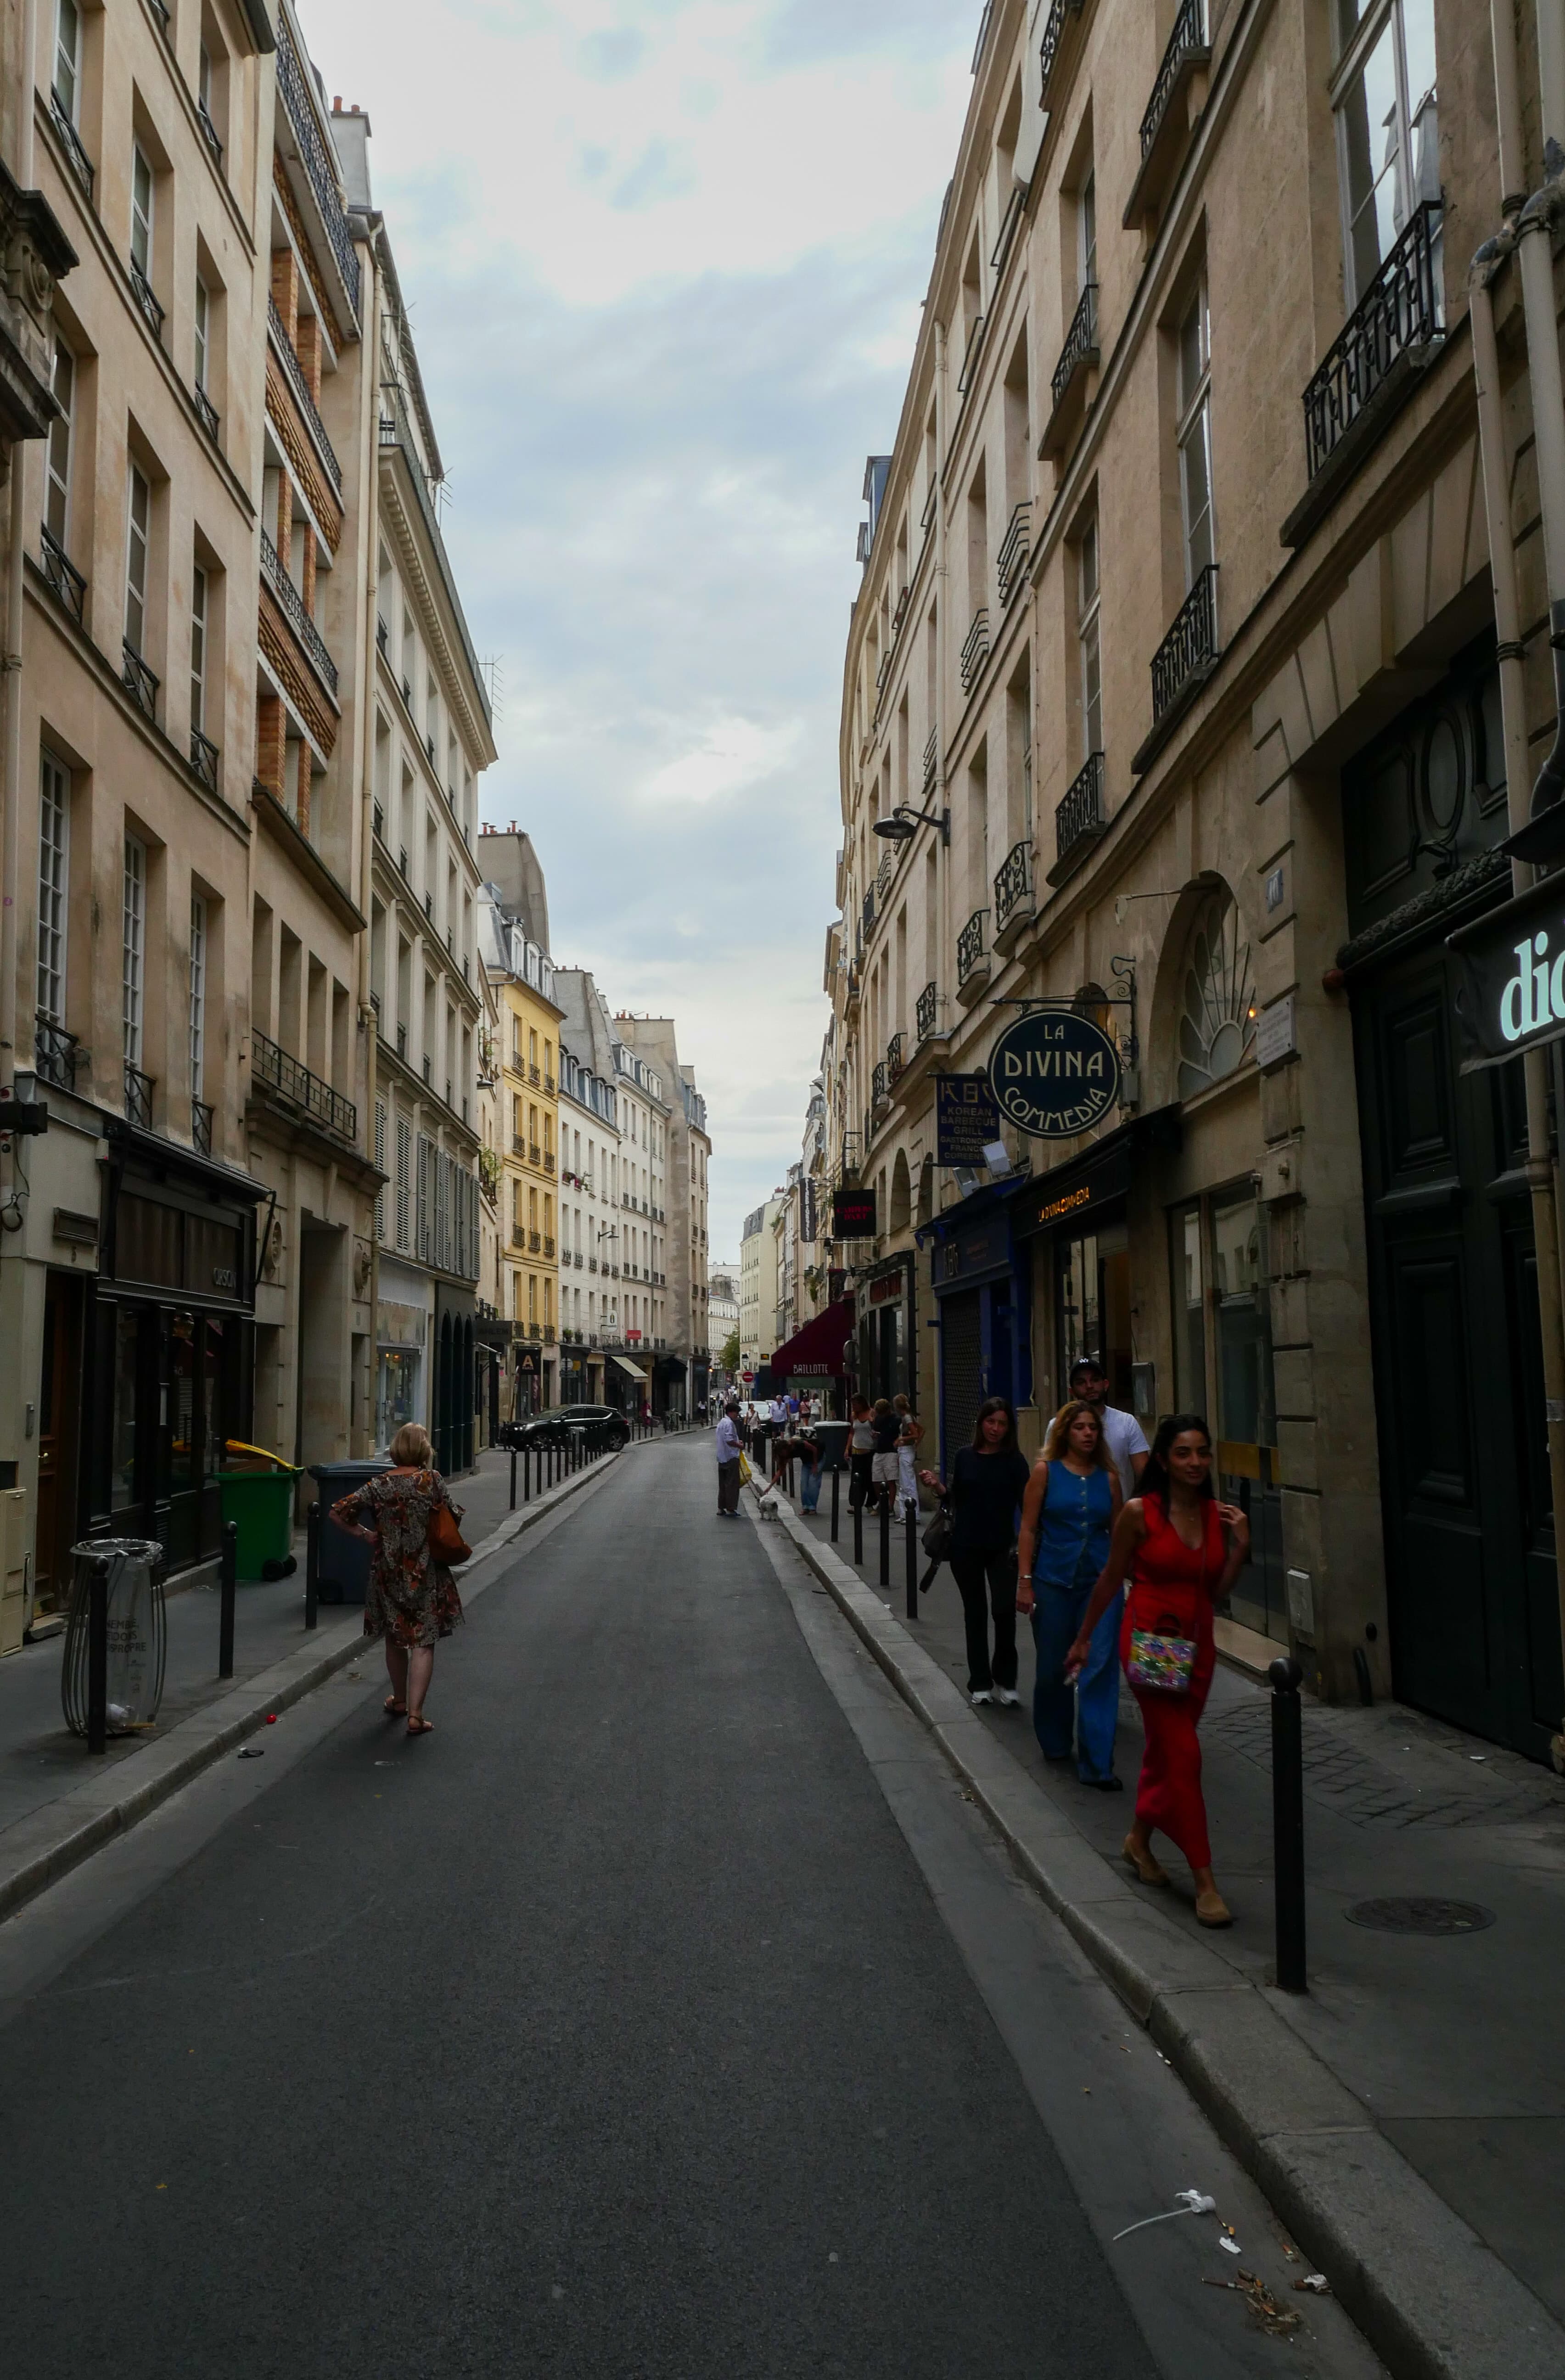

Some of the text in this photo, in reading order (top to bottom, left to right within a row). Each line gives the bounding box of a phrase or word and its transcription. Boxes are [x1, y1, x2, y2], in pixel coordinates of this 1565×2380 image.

[1044, 1024, 1065, 1040] LA
[1004, 1051, 1104, 1077] DIVINA
[947, 1107, 992, 1116] KOREAN
[1004, 1087, 1107, 1130] COMMEDIA
[941, 1116, 996, 1126] BARBECUE
[953, 1126, 983, 1135] GRILL
[793, 1364, 830, 1374] BAILLOTTE
